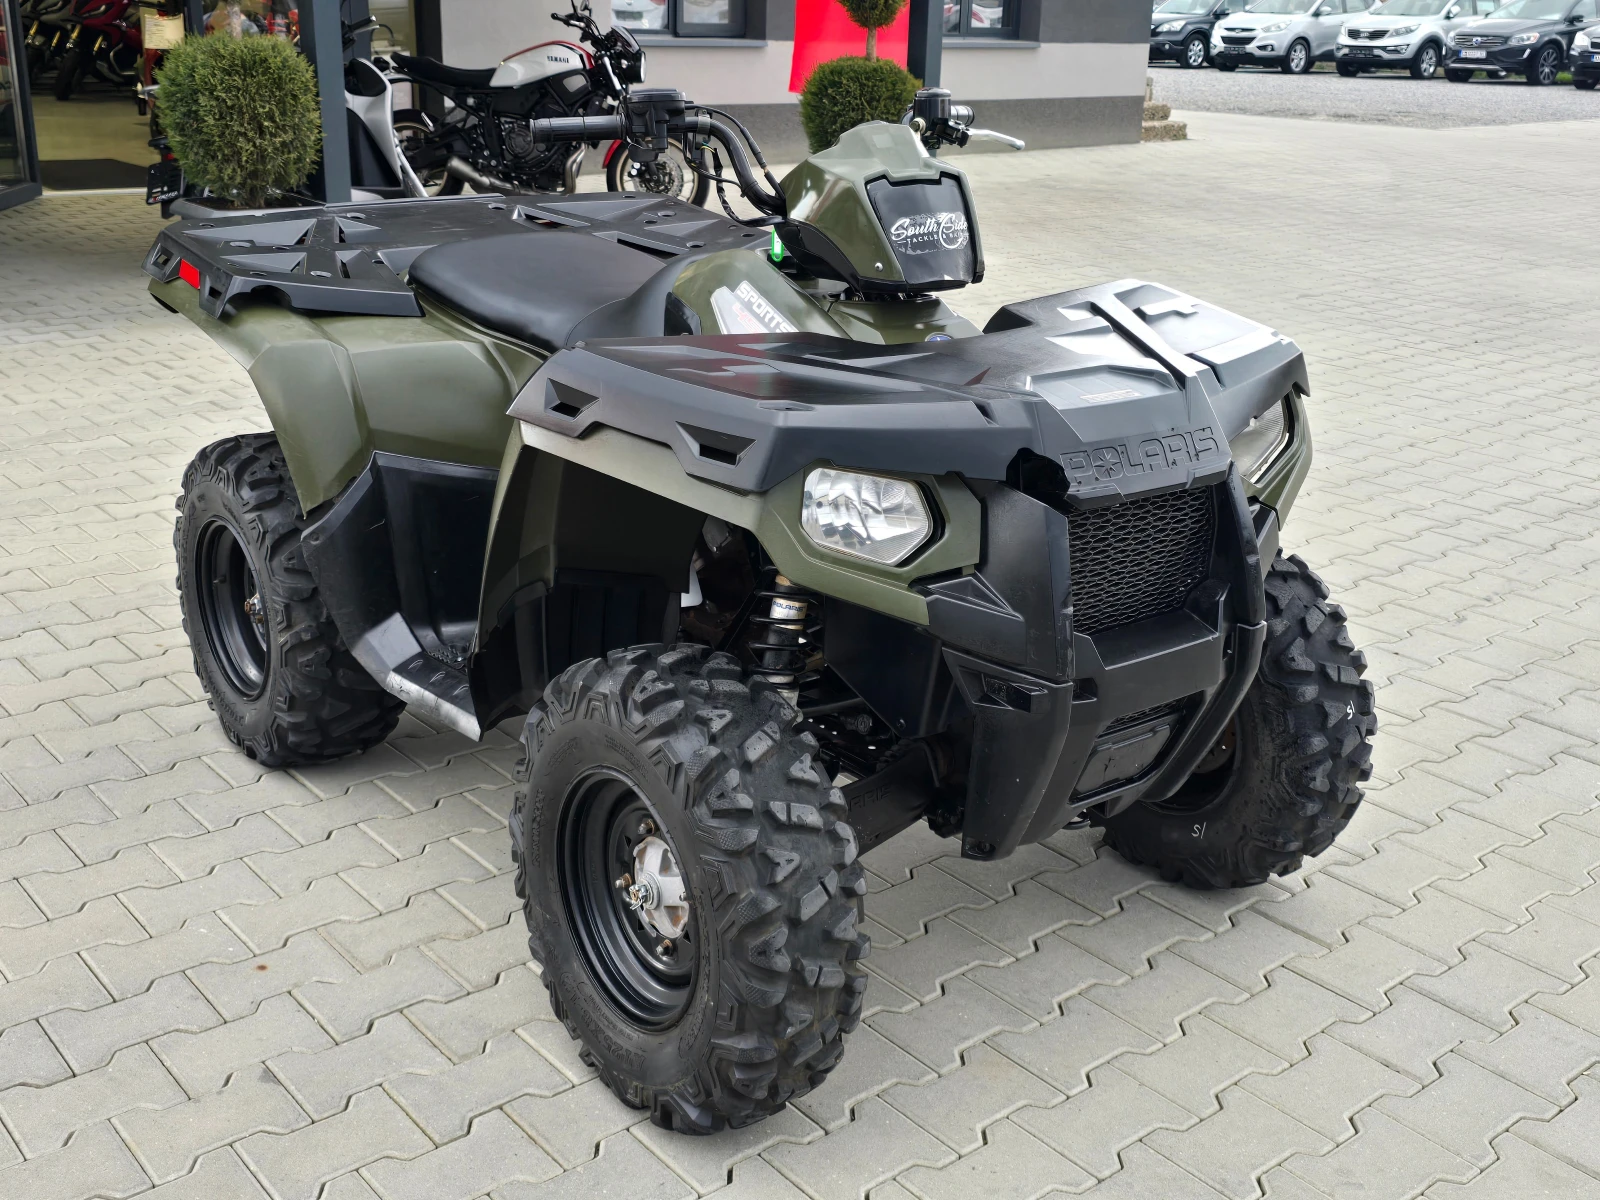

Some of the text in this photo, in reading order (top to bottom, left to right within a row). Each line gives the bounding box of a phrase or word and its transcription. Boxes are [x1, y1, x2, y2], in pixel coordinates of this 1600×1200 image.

[547, 55, 570, 64] YAMAHA
[890, 213, 968, 241] South Side
[907, 234, 938, 244] TACKLE
[1059, 426, 1220, 487] POLARIS
